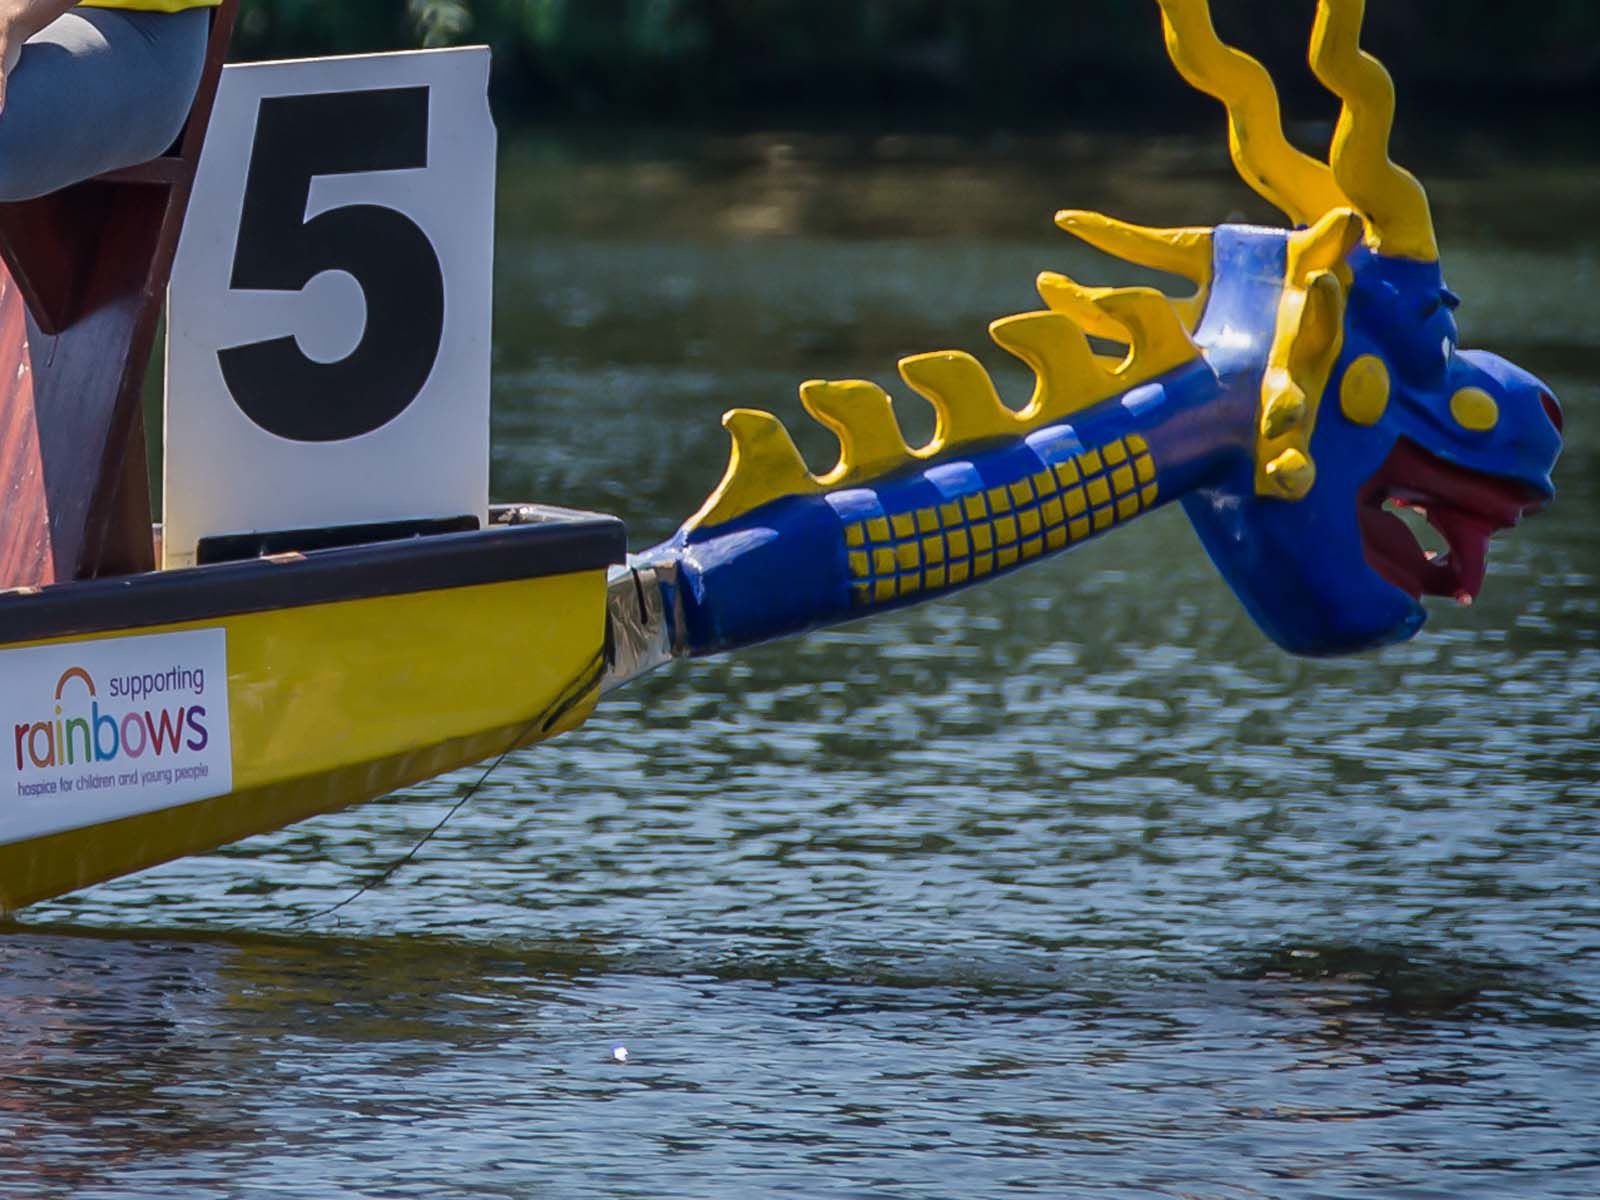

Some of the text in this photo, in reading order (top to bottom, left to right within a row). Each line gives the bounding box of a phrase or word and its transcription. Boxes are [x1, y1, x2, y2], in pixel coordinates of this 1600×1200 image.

[216, 85, 444, 443] 5
[109, 665, 205, 701] supporting
[14, 701, 209, 771] rainbows
[17, 763, 209, 797] hospice for children and young people
